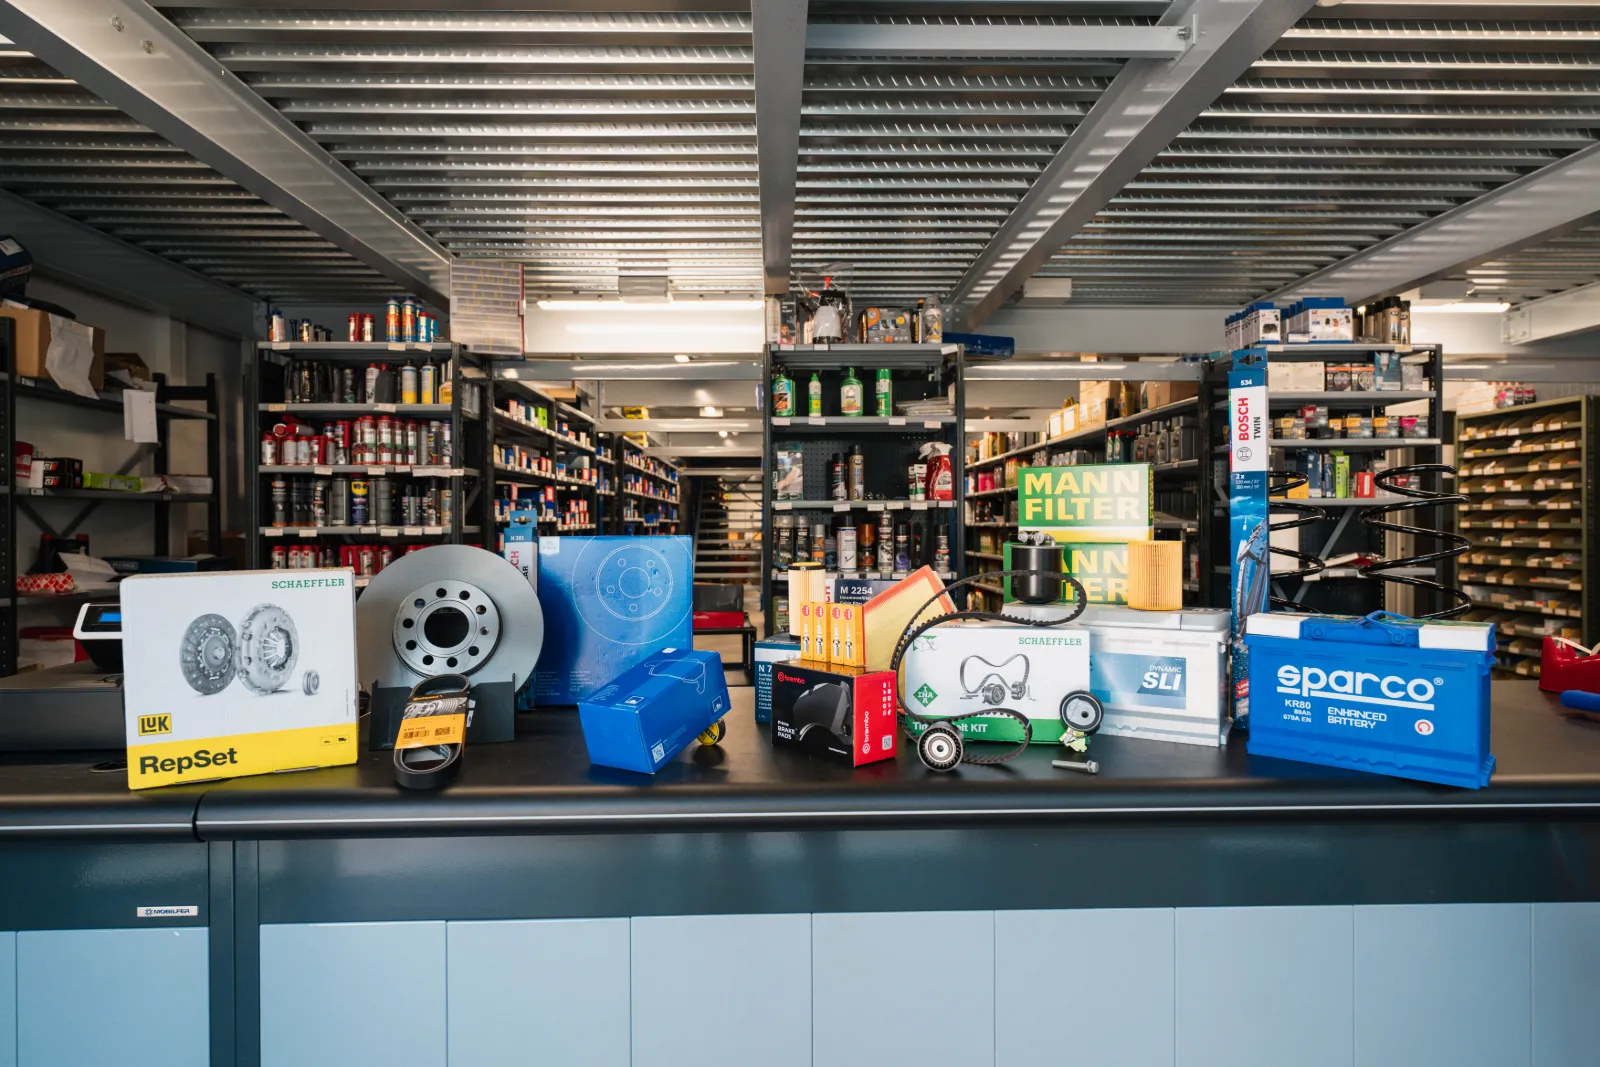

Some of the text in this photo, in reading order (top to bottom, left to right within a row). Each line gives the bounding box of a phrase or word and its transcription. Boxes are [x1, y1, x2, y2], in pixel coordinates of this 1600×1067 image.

[1238, 398, 1249, 441] BOSCH
[1253, 416, 1261, 440] TWIN
[1025, 470, 1140, 495] MANN
[1025, 496, 1140, 520] FILTER
[1061, 550, 1128, 574] NN
[271, 578, 345, 589] SCHAEFFLER
[840, 586, 874, 595] M 2254
[1018, 637, 1082, 646] SCHAEFFLER
[758, 664, 765, 672] N
[1149, 665, 1182, 673] DYNAMIC
[784, 675, 805, 684] brembo
[1142, 672, 1182, 690] SLI
[1284, 699, 1312, 709] KR80
[1327, 707, 1388, 721] ENHANCED
[1327, 716, 1377, 729] BATTERY
[777, 726, 796, 735] BRAKE
[970, 724, 988, 733] KIT
[777, 731, 793, 740] PADS
[139, 748, 238, 775] RepSet
